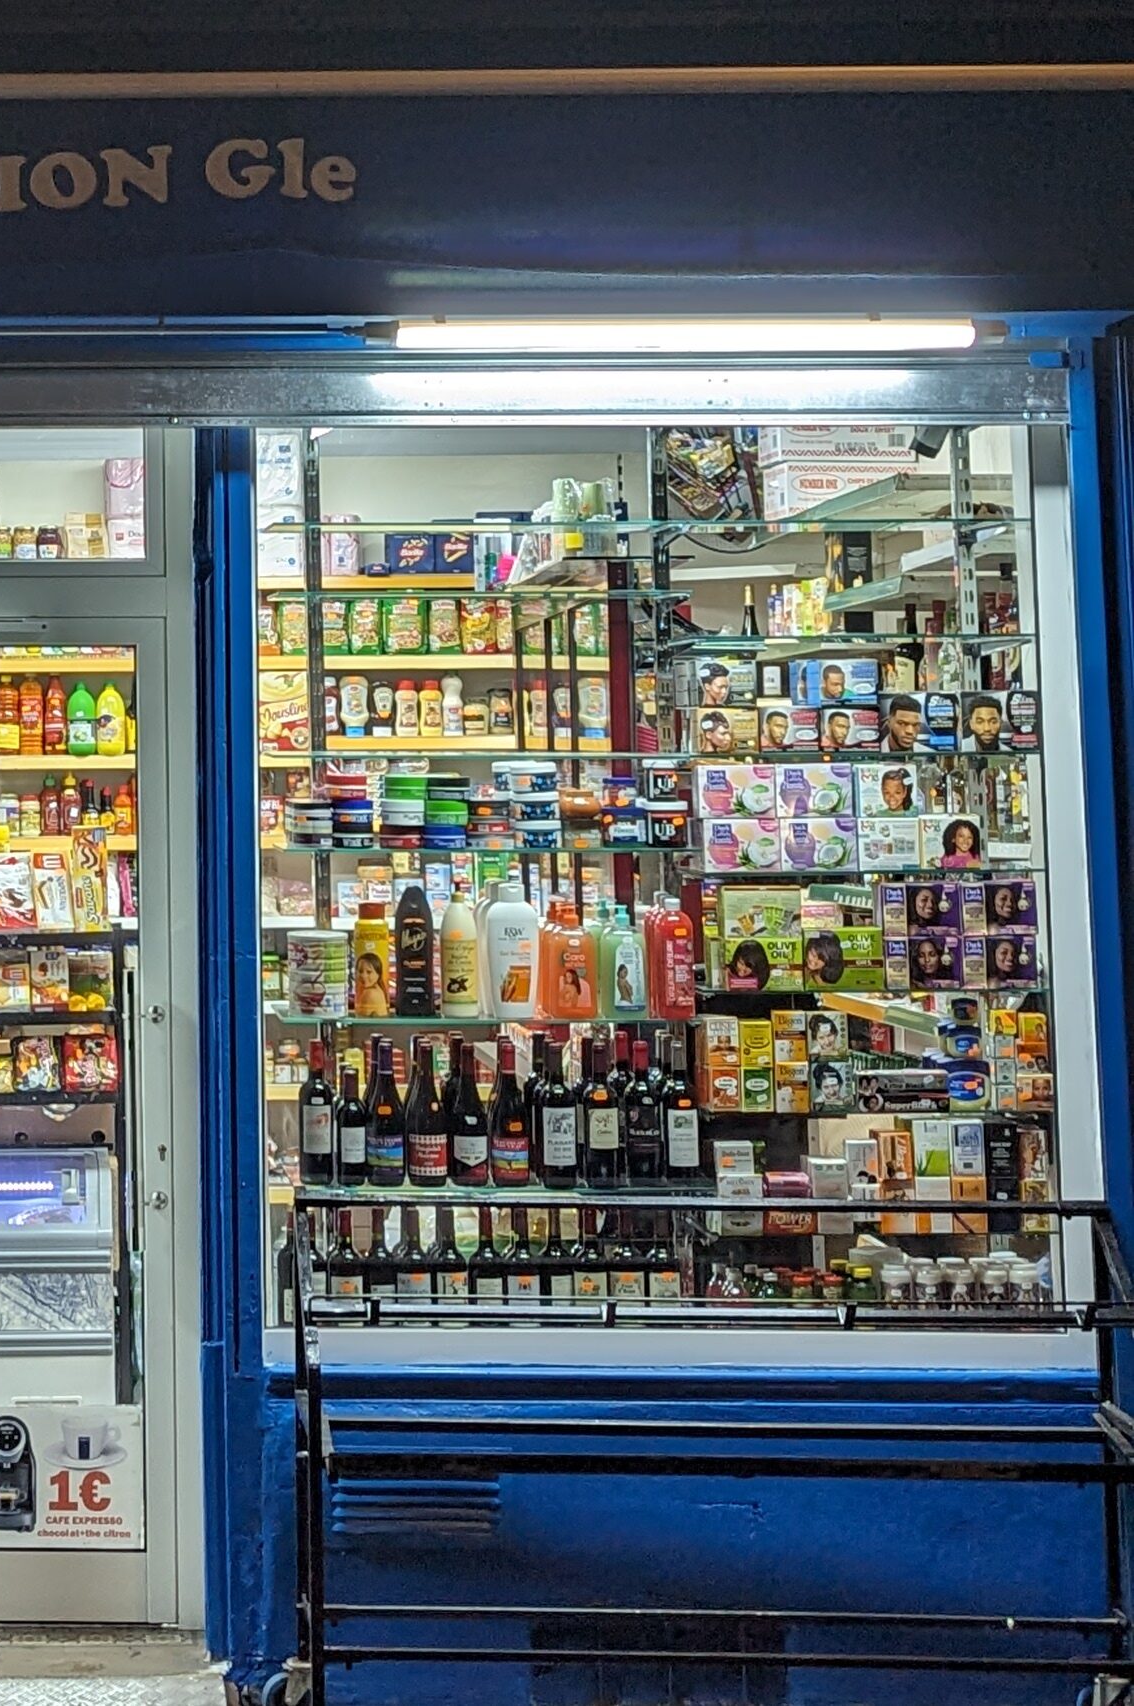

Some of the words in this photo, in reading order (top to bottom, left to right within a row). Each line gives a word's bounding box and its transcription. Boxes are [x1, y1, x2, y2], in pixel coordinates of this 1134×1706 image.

[204, 137, 356, 202] Gle
[848, 934, 875, 942] OLIVE
[767, 942, 797, 950] OLIVE
[563, 952, 585, 961] Caro
[778, 1015, 803, 1029] Bigen
[779, 1067, 804, 1080] Bigen
[768, 1212, 812, 1225] POWER
[48, 1470, 111, 1512] 1€
[45, 1516, 70, 1526] CAFE
[72, 1516, 123, 1526] EXPRESSO
[103, 1529, 131, 1539] citron
